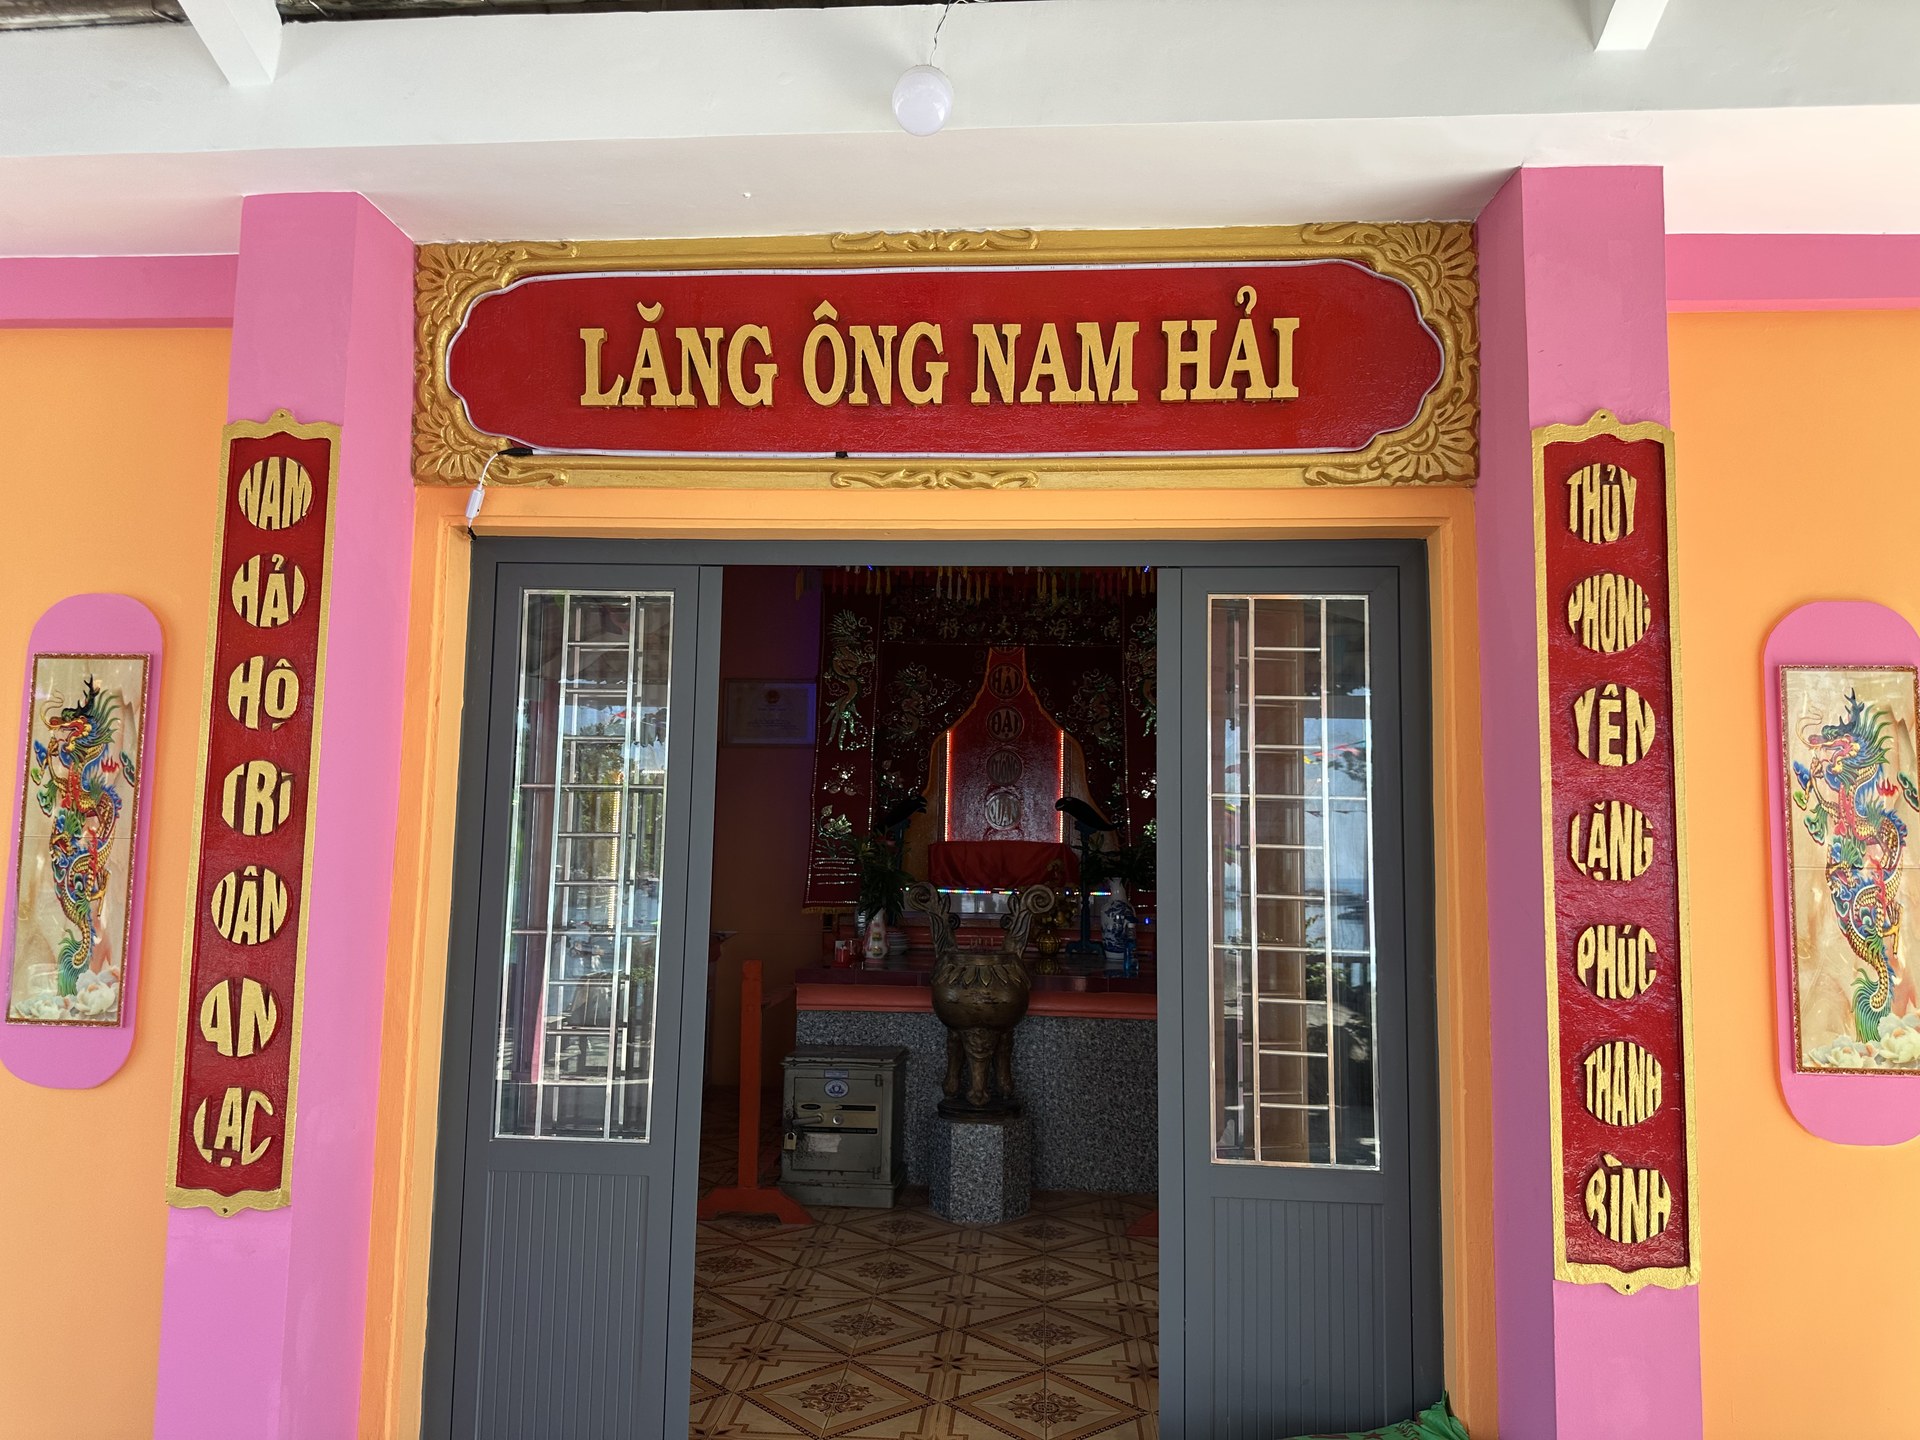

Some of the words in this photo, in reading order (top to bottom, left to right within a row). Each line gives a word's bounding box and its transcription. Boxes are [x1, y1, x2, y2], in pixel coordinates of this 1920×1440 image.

[581, 302, 777, 406] LĂNG
[804, 301, 948, 406] ÔNG
[972, 322, 1139, 404] NAM
[1161, 286, 1299, 401] HẢI
[239, 457, 312, 529] NAM
[1568, 464, 1636, 543] THỦY
[232, 555, 304, 627] HẢI
[229, 656, 298, 728] HỘ
[1575, 684, 1655, 766] YÊN
[1571, 801, 1653, 880] LẶNG
[212, 866, 287, 944] DÂN
[1578, 925, 1656, 999] PHÚC
[200, 979, 276, 1056] AN
[1584, 1042, 1662, 1126] THANH
[194, 1088, 273, 1166] LẠC
